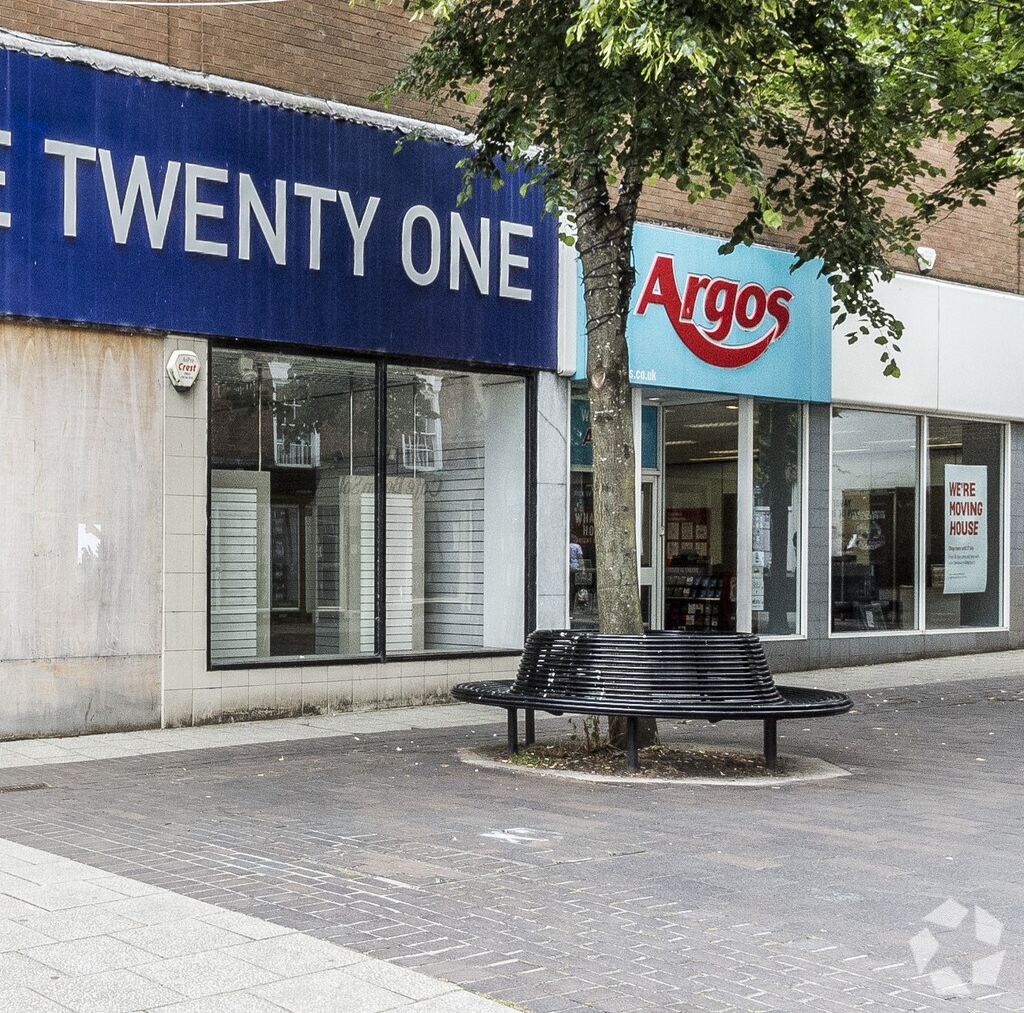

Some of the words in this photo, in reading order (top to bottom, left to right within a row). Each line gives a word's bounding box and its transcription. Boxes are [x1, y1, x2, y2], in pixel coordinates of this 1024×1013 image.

[44, 138, 381, 277] TWENTY
[401, 205, 534, 301] ONE
[634, 252, 795, 368] Argos
[179, 363, 196, 372] Crest
[629, 369, 657, 381] s.co.uk
[949, 482, 976, 497] WE'RE
[949, 501, 983, 517] MOVING
[949, 520, 979, 536] HOUSE
